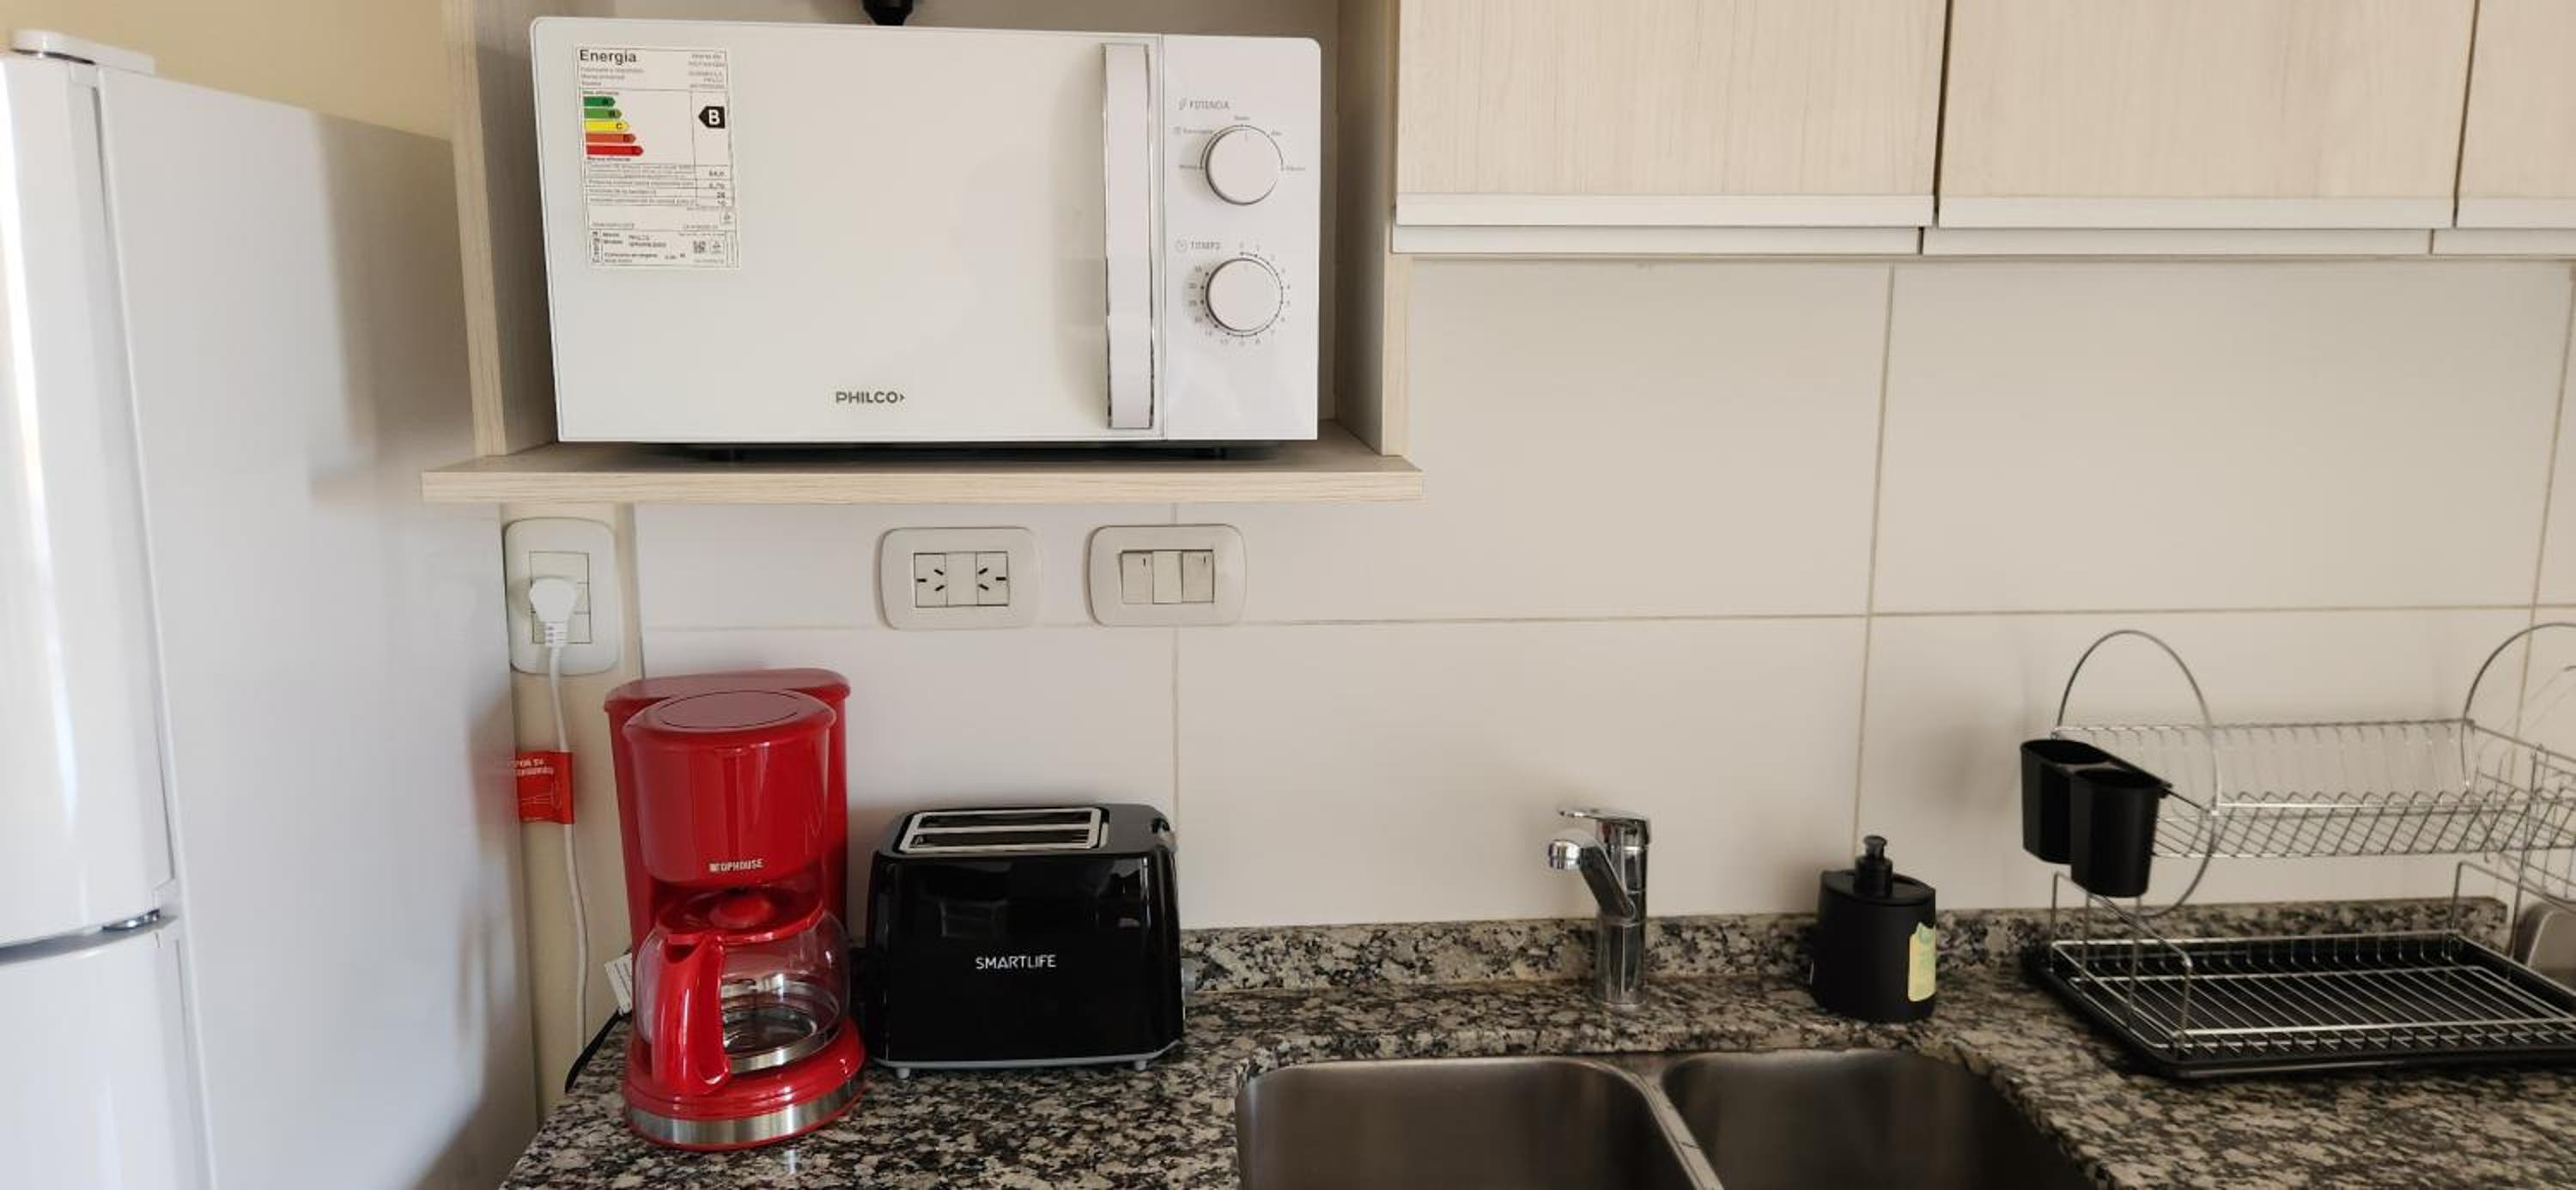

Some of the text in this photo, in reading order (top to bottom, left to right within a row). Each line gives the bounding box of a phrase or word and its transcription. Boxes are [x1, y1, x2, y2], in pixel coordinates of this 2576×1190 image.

[708, 109, 720, 125] B
[835, 391, 899, 404] PHILCO
[975, 954, 1057, 969] SMARTLIFE
